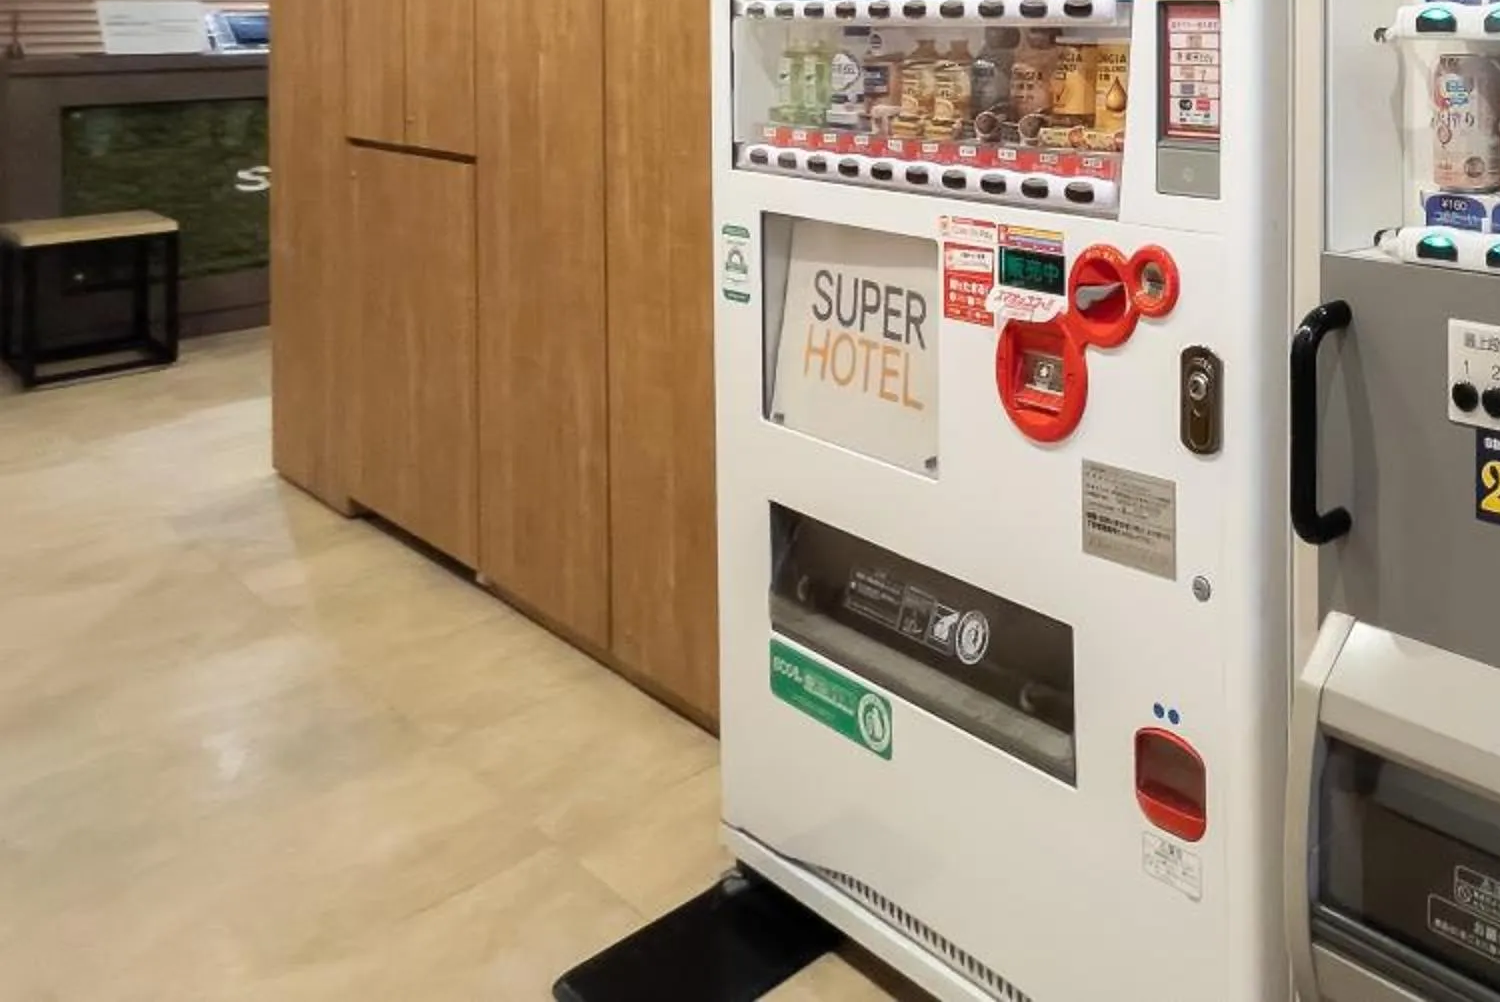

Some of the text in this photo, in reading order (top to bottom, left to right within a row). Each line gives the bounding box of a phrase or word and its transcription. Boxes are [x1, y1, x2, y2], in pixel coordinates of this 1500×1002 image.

[812, 269, 928, 350] SUPER
[803, 323, 926, 411] HOTEL
[1464, 359, 1470, 375] 1
[1491, 365, 1500, 380] 2
